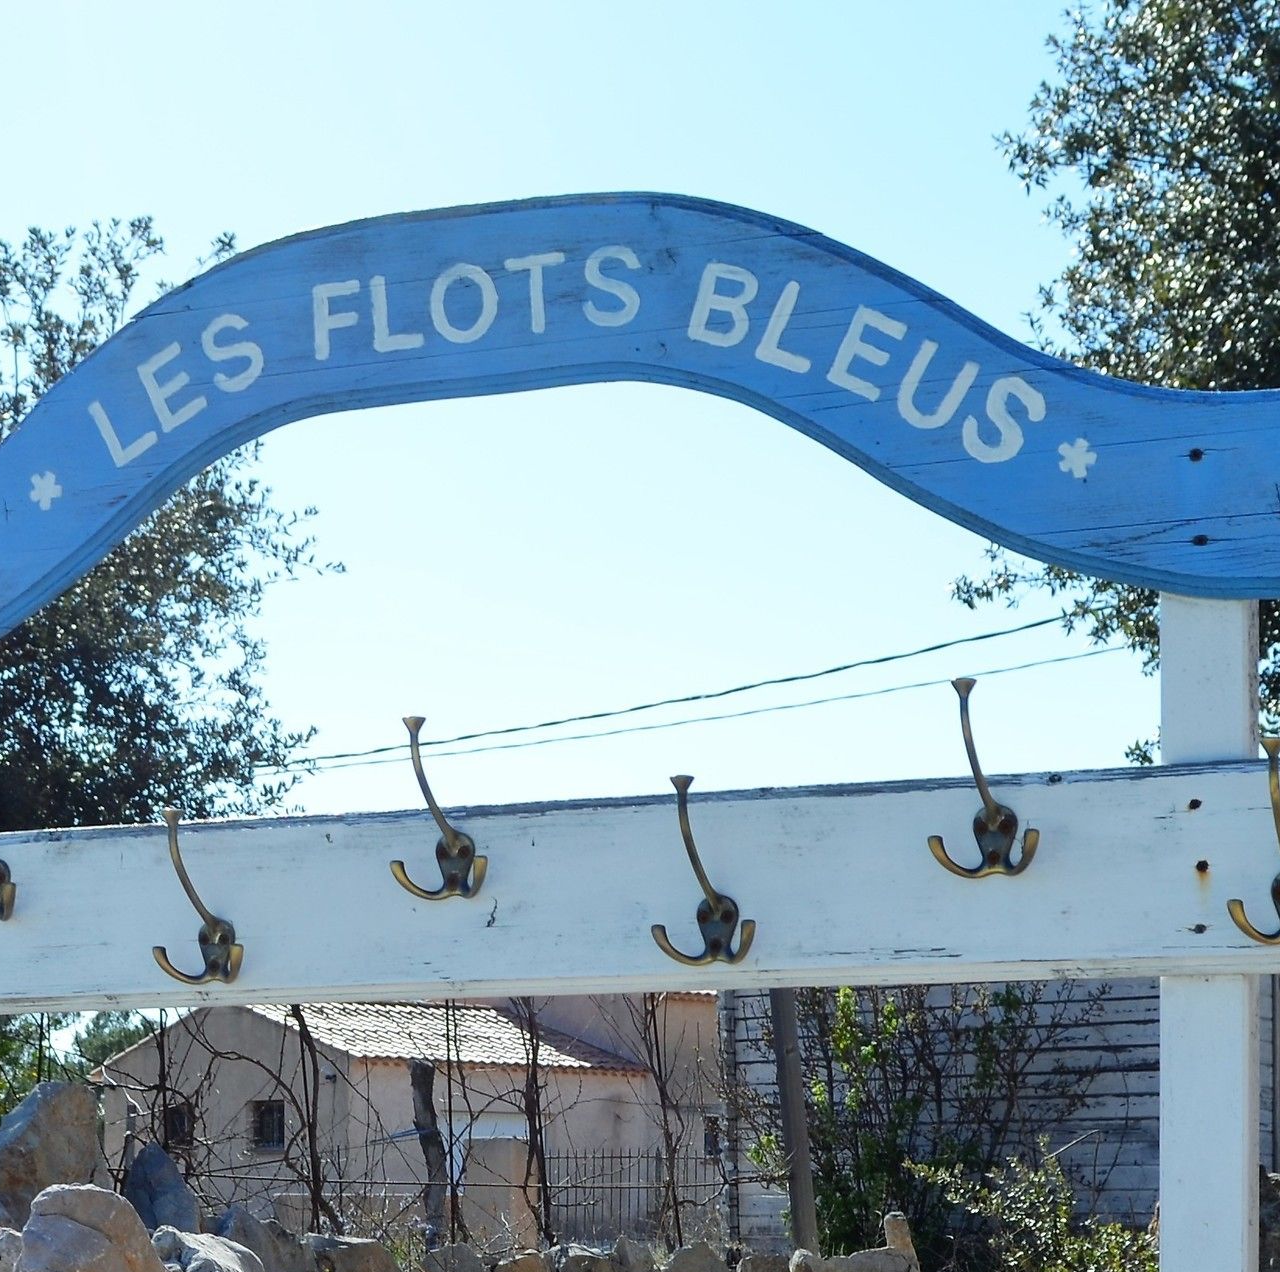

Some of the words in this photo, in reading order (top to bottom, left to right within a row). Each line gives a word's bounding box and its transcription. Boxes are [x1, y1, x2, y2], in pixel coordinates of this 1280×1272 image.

[89, 313, 265, 467] LES
[313, 244, 642, 361] FLOTS
[687, 262, 1047, 463] BLEUS
